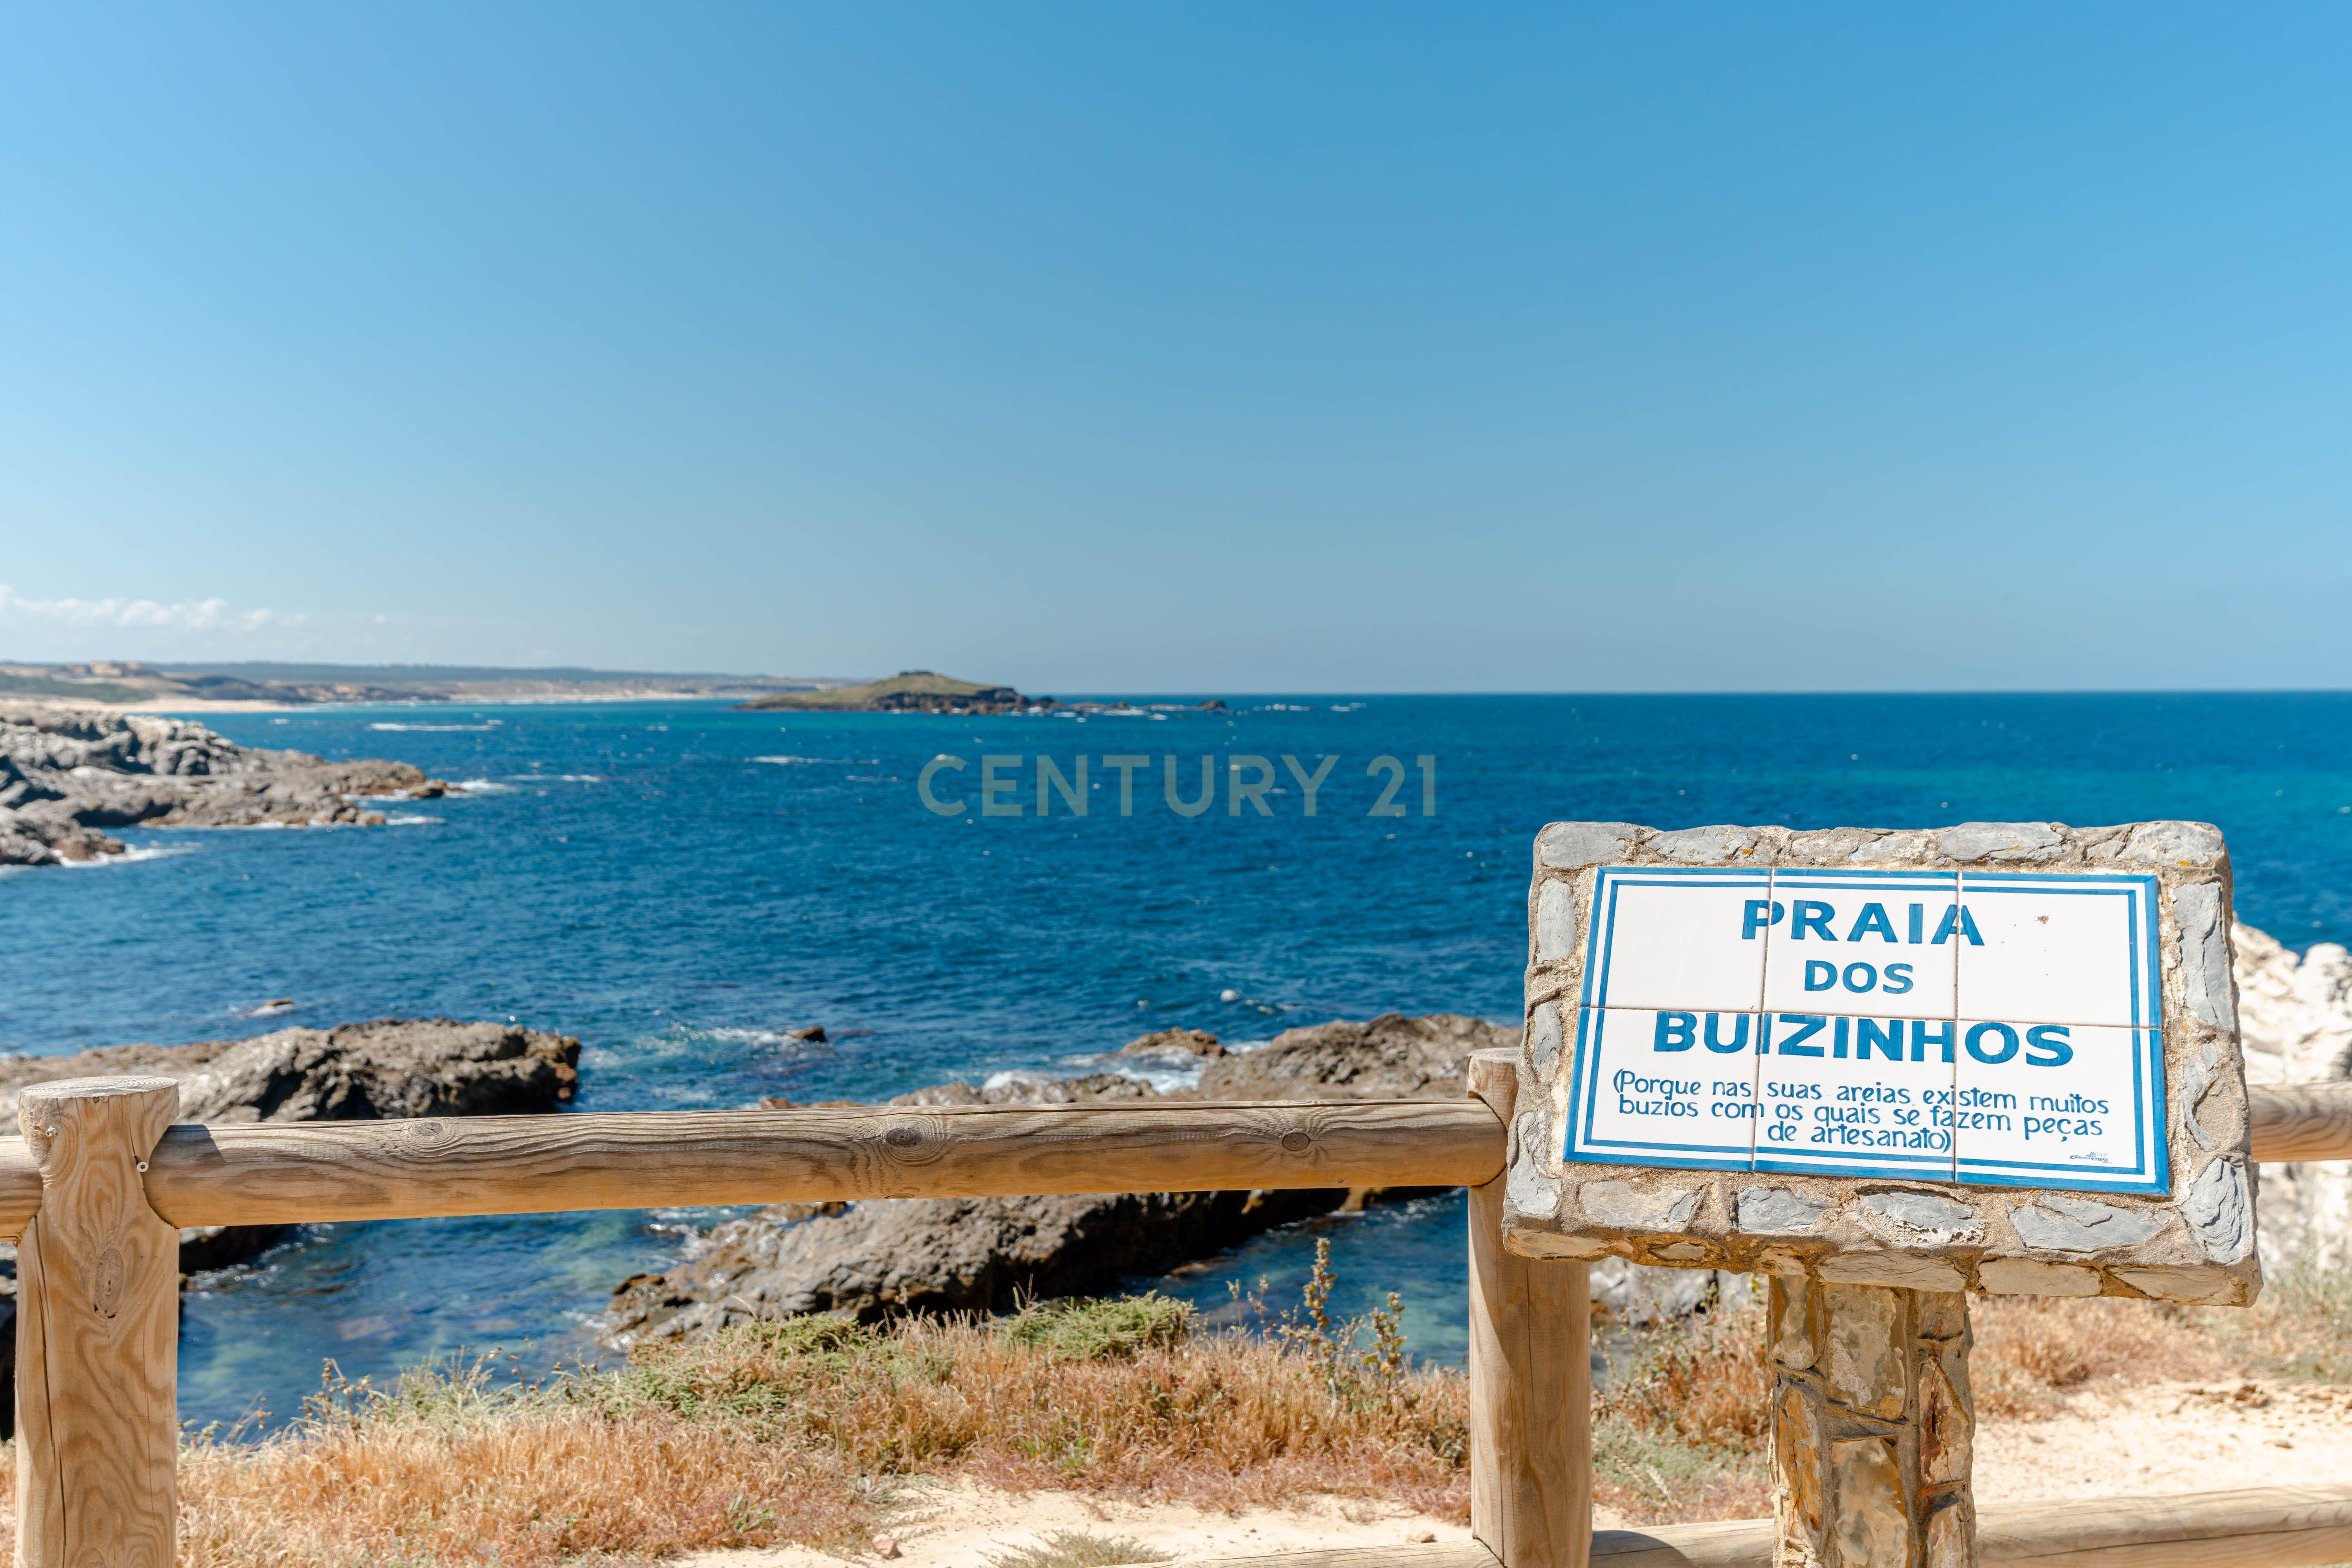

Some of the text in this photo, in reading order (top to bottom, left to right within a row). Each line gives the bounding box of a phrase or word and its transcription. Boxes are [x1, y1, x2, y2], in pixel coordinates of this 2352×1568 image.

[1742, 900, 1984, 946] PRAIA
[1805, 960, 1913, 994] DOS
[1654, 1011, 2073, 1066] BUIZINHOS
[1613, 1068, 2109, 1114] (Porque nas suas areias existem muitos
[1620, 1094, 2103, 1142] buzios com os quais se fazem peças
[1768, 1120, 1951, 1153] de artesanato)
